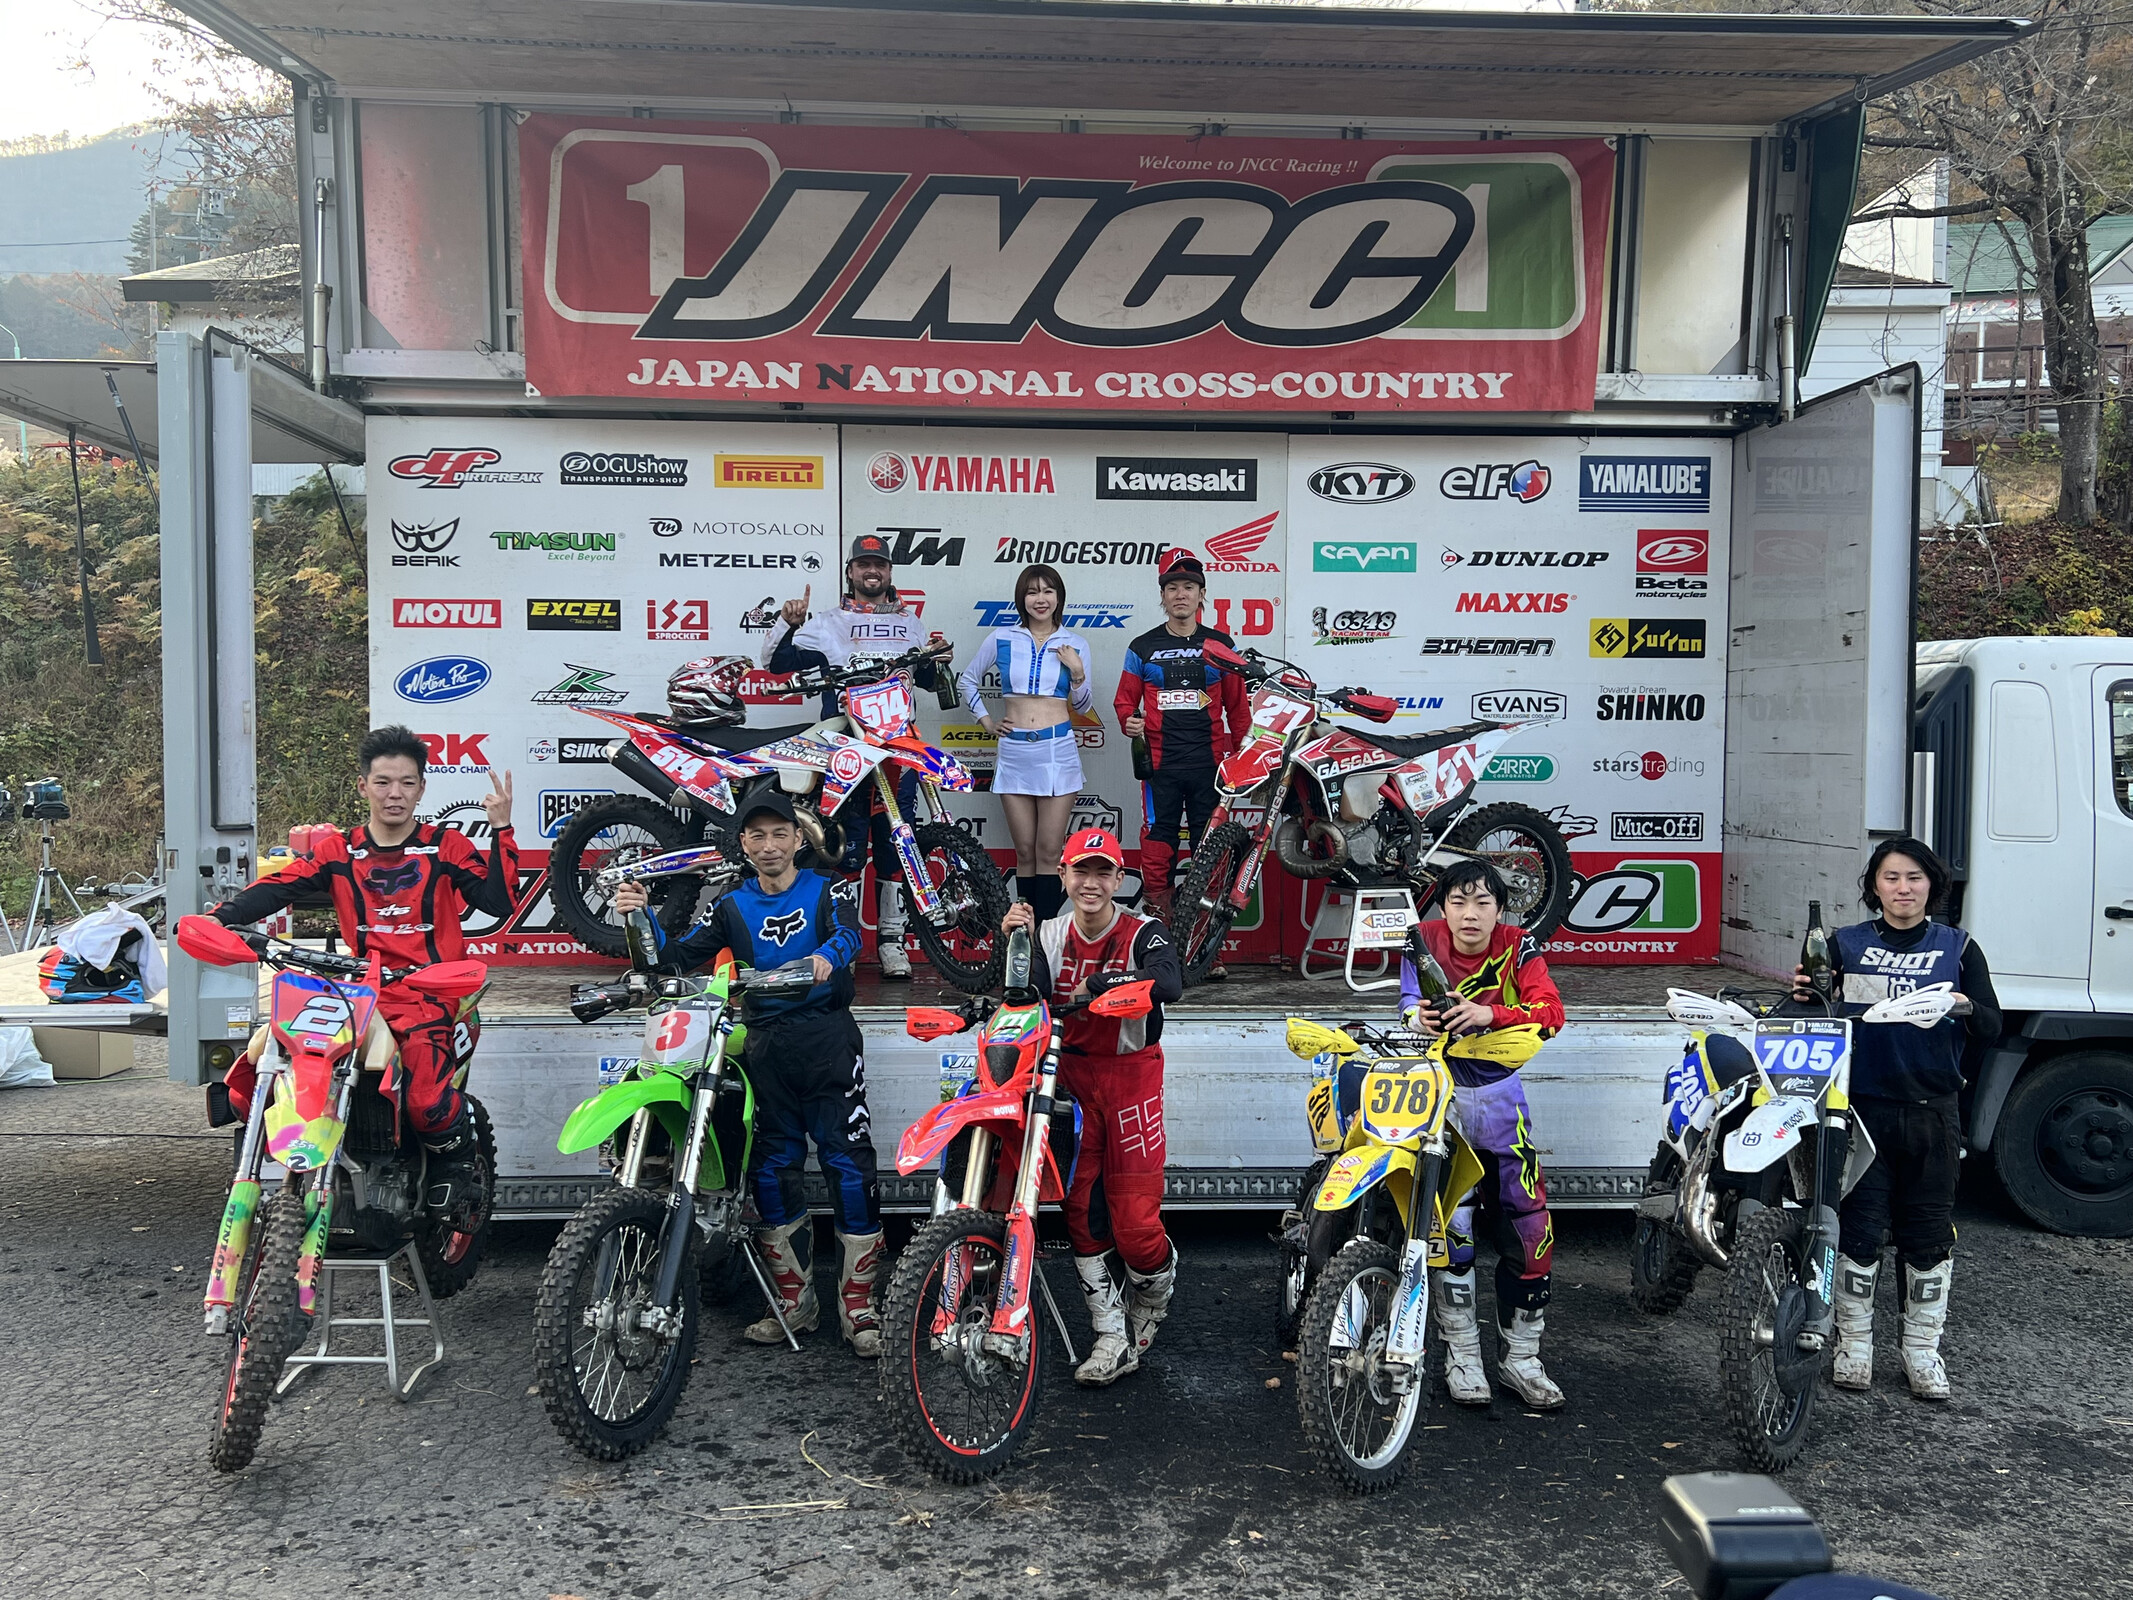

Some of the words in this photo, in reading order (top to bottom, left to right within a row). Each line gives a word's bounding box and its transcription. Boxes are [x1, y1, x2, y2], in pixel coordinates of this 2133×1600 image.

[1138, 155, 1201, 171] Welcome
[1206, 158, 1233, 172] to
[1237, 158, 1283, 174] JNCC
[1285, 159, 1343, 176] Racing
[628, 165, 686, 296] 1
[632, 169, 1476, 348] JNCC
[627, 358, 804, 391] JAPAN
[816, 362, 1084, 398] NATIONAL
[1094, 371, 1513, 401] CROSS-COUNTRY
[593, 457, 684, 475] OGUshow
[724, 461, 816, 483] PIRELLI
[911, 456, 1055, 494] YAMAHA
[452, 472, 543, 485] DIRTFREAK
[564, 475, 633, 483] TRANSPORTER
[636, 476, 685, 485] PRO-SHOP
[1107, 466, 1247, 493] Kawasaki
[1321, 471, 1402, 497] KYT
[1442, 463, 1513, 499] elf
[1589, 463, 1703, 495] YAMALUBE
[692, 521, 825, 537] MOTOSALON
[489, 531, 616, 551] TIMSUN
[994, 536, 1170, 566] BRIDGESTONE
[391, 555, 462, 568] BERIK
[547, 552, 574, 561] Excel
[577, 552, 616, 563] Beyond
[659, 552, 798, 569] METZELER
[1203, 562, 1281, 574] HONDA
[1466, 550, 1609, 568] DUNLOP
[1635, 577, 1709, 591] Beta
[1067, 602, 1135, 611] suspension
[1455, 592, 1569, 614] MAXXIS
[1635, 591, 1708, 600] motorcycles
[398, 603, 498, 625] MOTUL
[530, 602, 618, 617] EXCEL
[1333, 610, 1397, 631] 6348
[654, 632, 702, 641] SPROCKET
[1420, 636, 1556, 657] BIKEMAN
[1149, 648, 1204, 661] KENN
[405, 665, 452, 695] Motion
[448, 663, 488, 686] Pro
[1599, 685, 1630, 694] Toward
[1638, 685, 1667, 694] Dream
[530, 691, 630, 703] RESPONSE
[1158, 690, 1199, 705] RG3
[1477, 696, 1561, 714] EVANS
[860, 690, 909, 728] 514
[1253, 695, 1311, 734] 27
[528, 746, 557, 756] FUCHS
[460, 766, 492, 774] CHAIN
[649, 744, 707, 782] 514
[1316, 749, 1386, 780] GASGAS
[1437, 745, 1476, 800] 27
[1485, 759, 1543, 777] CARRY
[689, 785, 704, 797] RED
[702, 791, 717, 805] LINE
[714, 800, 726, 810] OIL
[1269, 786, 1288, 823] RG3
[1616, 818, 1696, 837] Muc-Off
[896, 843, 917, 887] DUNLOP
[1371, 913, 1408, 928] RG3
[1362, 931, 1380, 940] RK
[1860, 946, 1945, 972] SHOT
[1876, 967, 1904, 975] RACE
[1905, 968, 1933, 976] GEAR
[286, 995, 356, 1038] 2
[1678, 1013, 1715, 1021] ACERBIS
[1903, 1009, 1938, 1018] ACERBIS
[453, 1021, 473, 1062] 2
[655, 1011, 692, 1052] 3
[1762, 1039, 1836, 1072] 705
[1371, 1079, 1431, 1116] 378
[215, 1202, 238, 1282] DUNLOP
[310, 1213, 328, 1293] DUNLOP
[1823, 1247, 1835, 1306] MICHELIN
[1845, 1270, 1873, 1298] G
[1442, 1282, 1473, 1308] G
[1912, 1276, 1943, 1303] G
